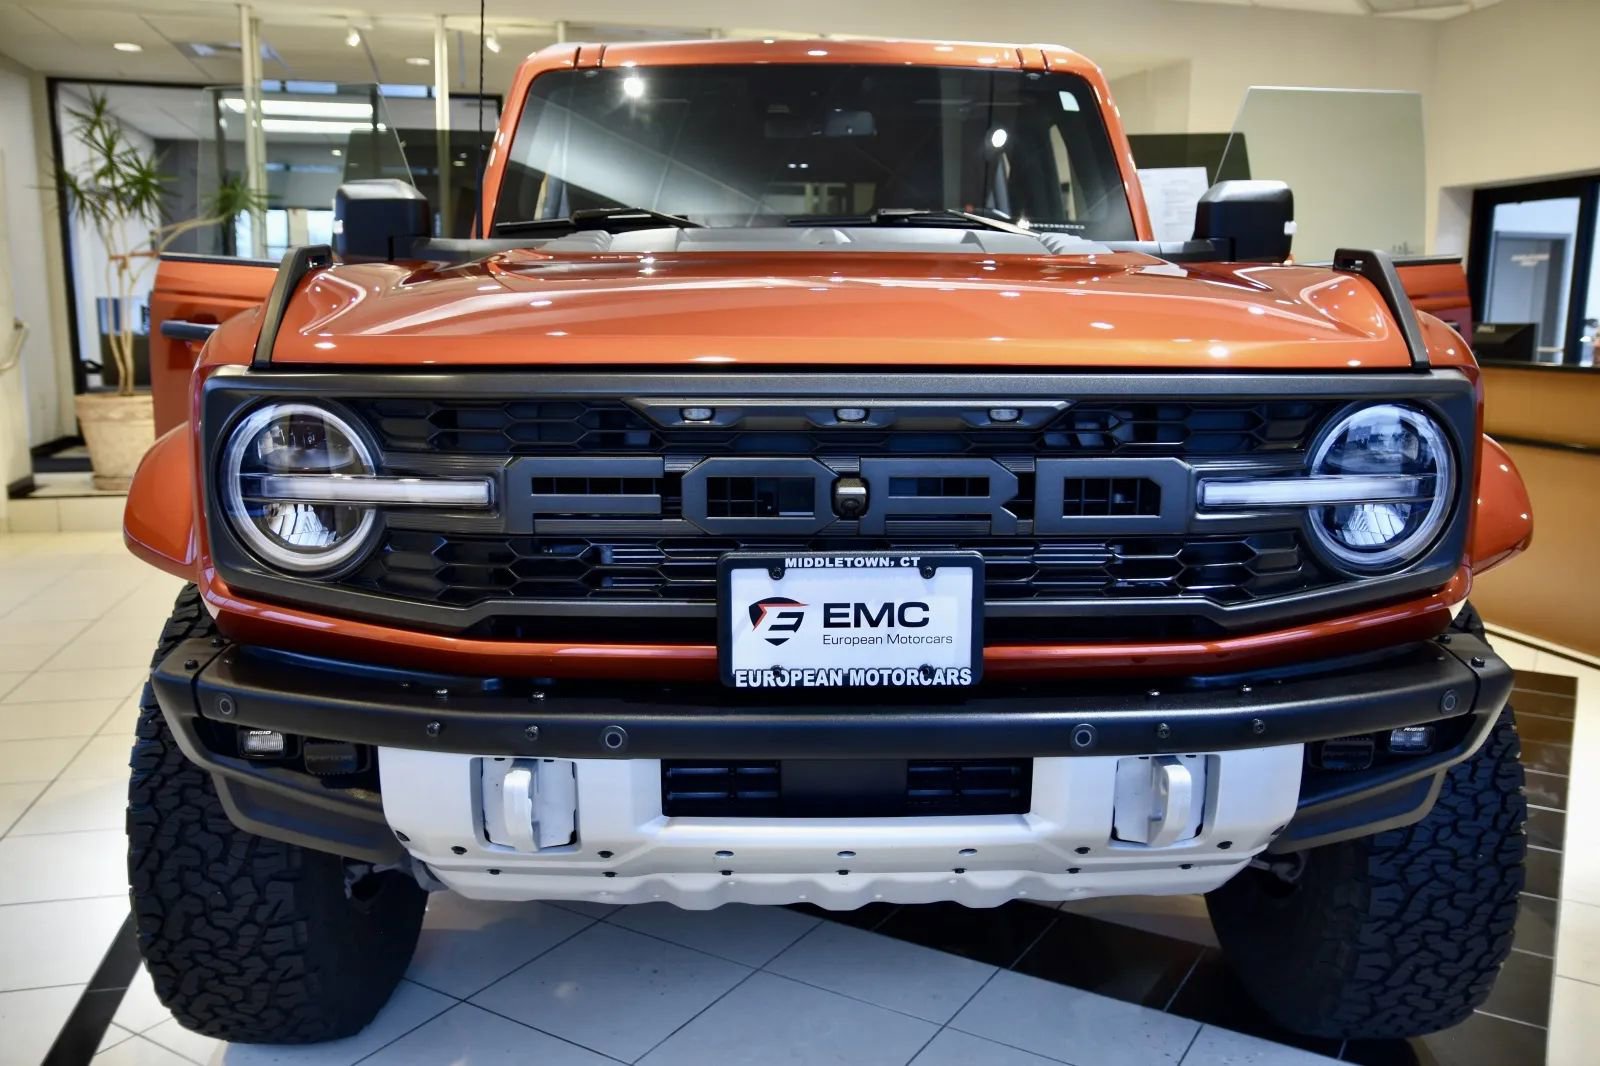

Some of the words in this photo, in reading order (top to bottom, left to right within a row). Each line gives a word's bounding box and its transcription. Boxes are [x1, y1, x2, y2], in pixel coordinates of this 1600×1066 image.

[504, 456, 1193, 536] FORD
[784, 557, 895, 568] MIDDLETOWN,
[900, 556, 920, 567] CT
[823, 601, 930, 629] EMC
[823, 634, 883, 647] European
[886, 633, 953, 645] Motorcars
[734, 669, 844, 688] EUROPEAN
[849, 667, 972, 687] MOTORCARS
